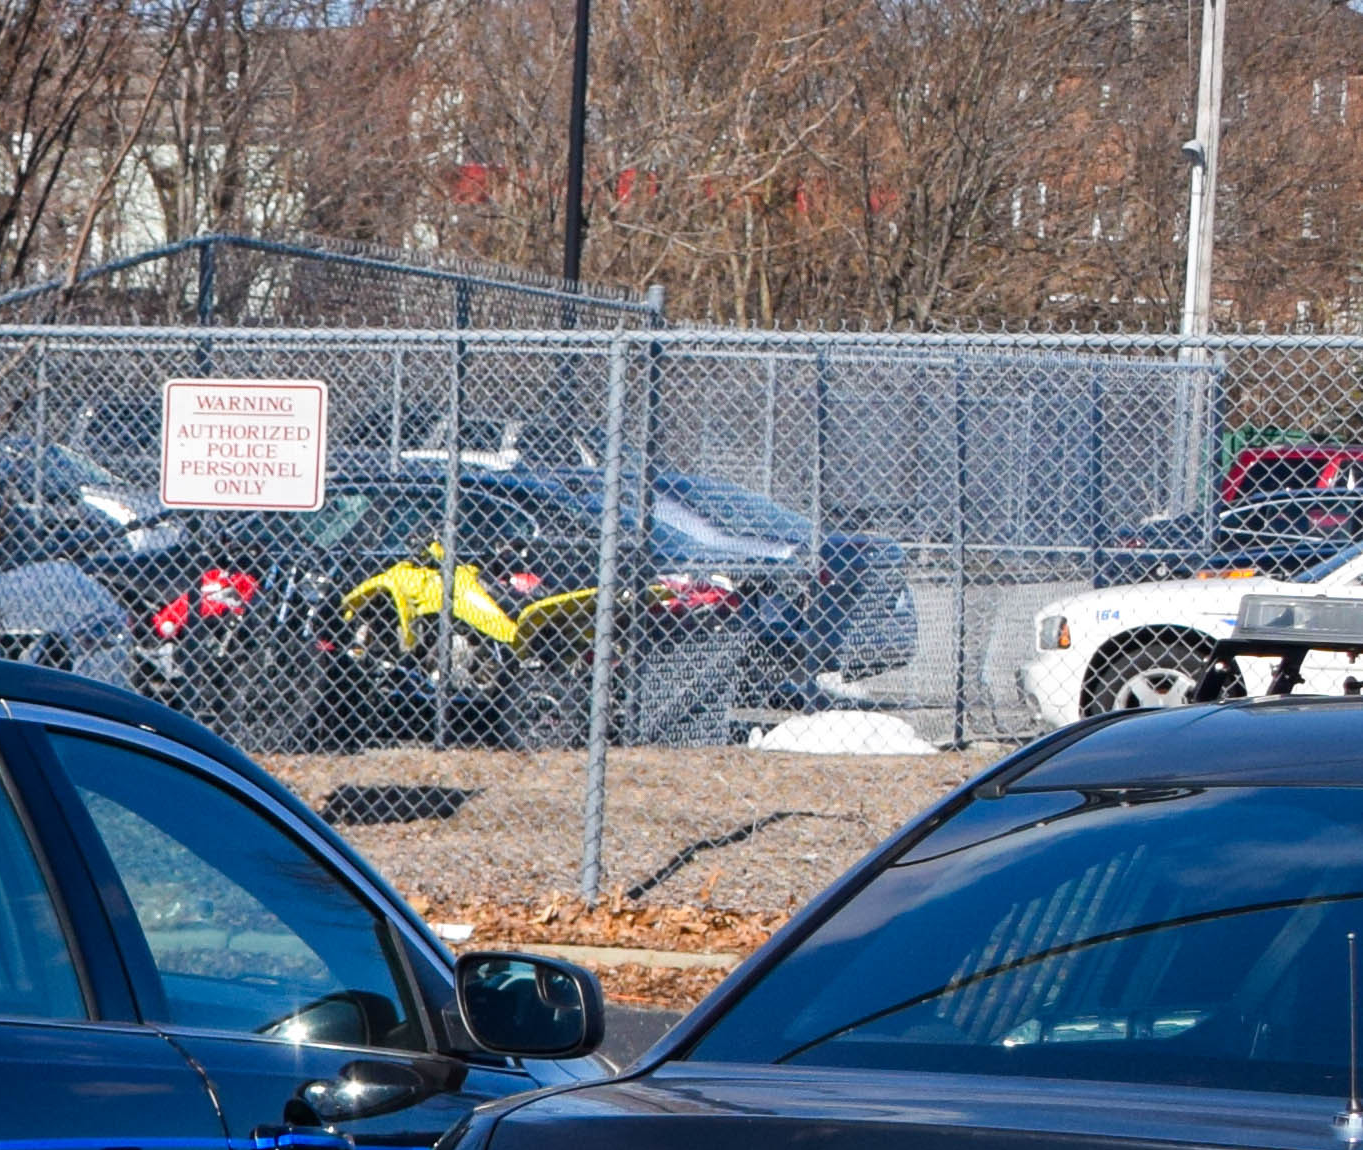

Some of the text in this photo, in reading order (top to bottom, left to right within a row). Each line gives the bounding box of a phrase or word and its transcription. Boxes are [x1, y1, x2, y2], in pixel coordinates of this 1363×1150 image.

[197, 395, 293, 412] WARNING
[177, 424, 311, 441] AUTHORIZED
[207, 443, 278, 459] POLICE
[181, 461, 303, 478] PERSONNEL
[214, 480, 266, 495] ONLY
